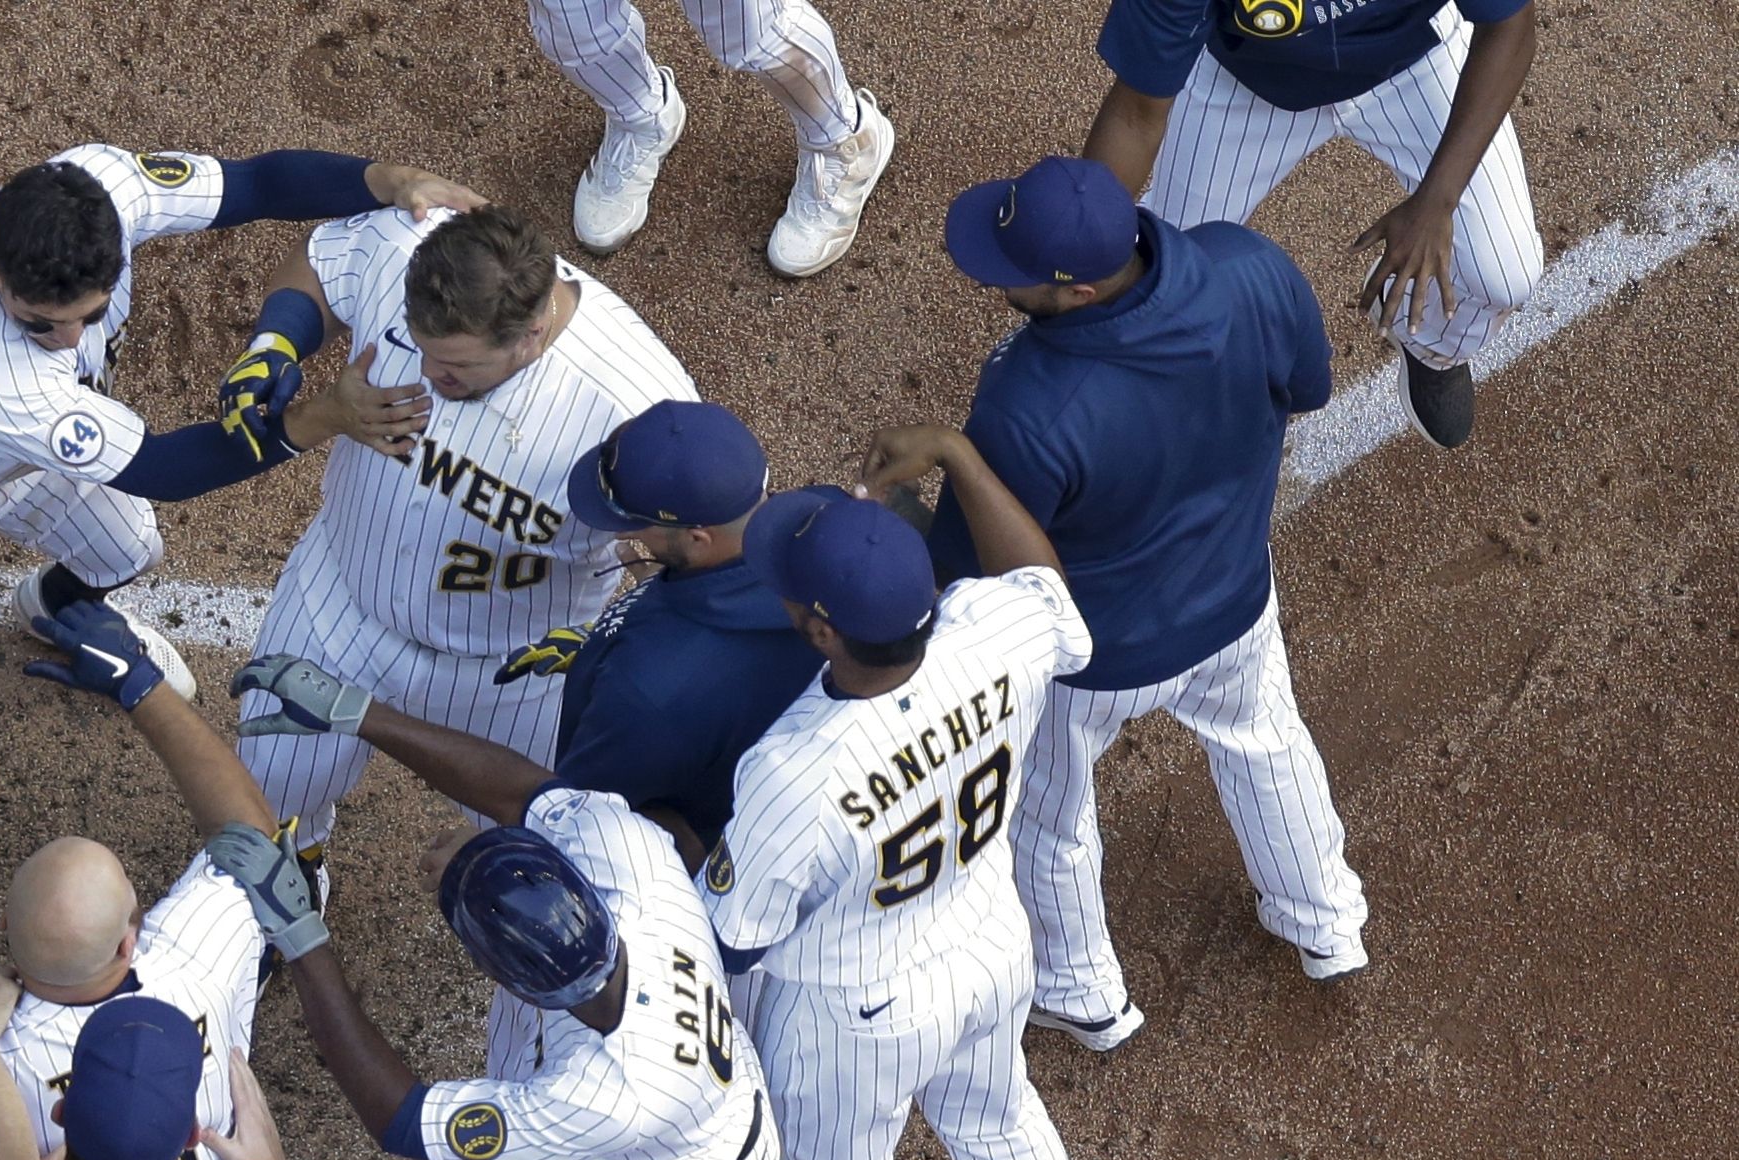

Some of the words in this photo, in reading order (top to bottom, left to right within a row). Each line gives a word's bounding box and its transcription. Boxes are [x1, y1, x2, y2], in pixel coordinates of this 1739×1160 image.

[58, 418, 99, 460] 44
[389, 436, 565, 545] WERS
[437, 538, 553, 593] 20
[838, 672, 1014, 831] SANCHEZ
[871, 739, 1013, 909] 58
[673, 946, 701, 1067] CAIN
